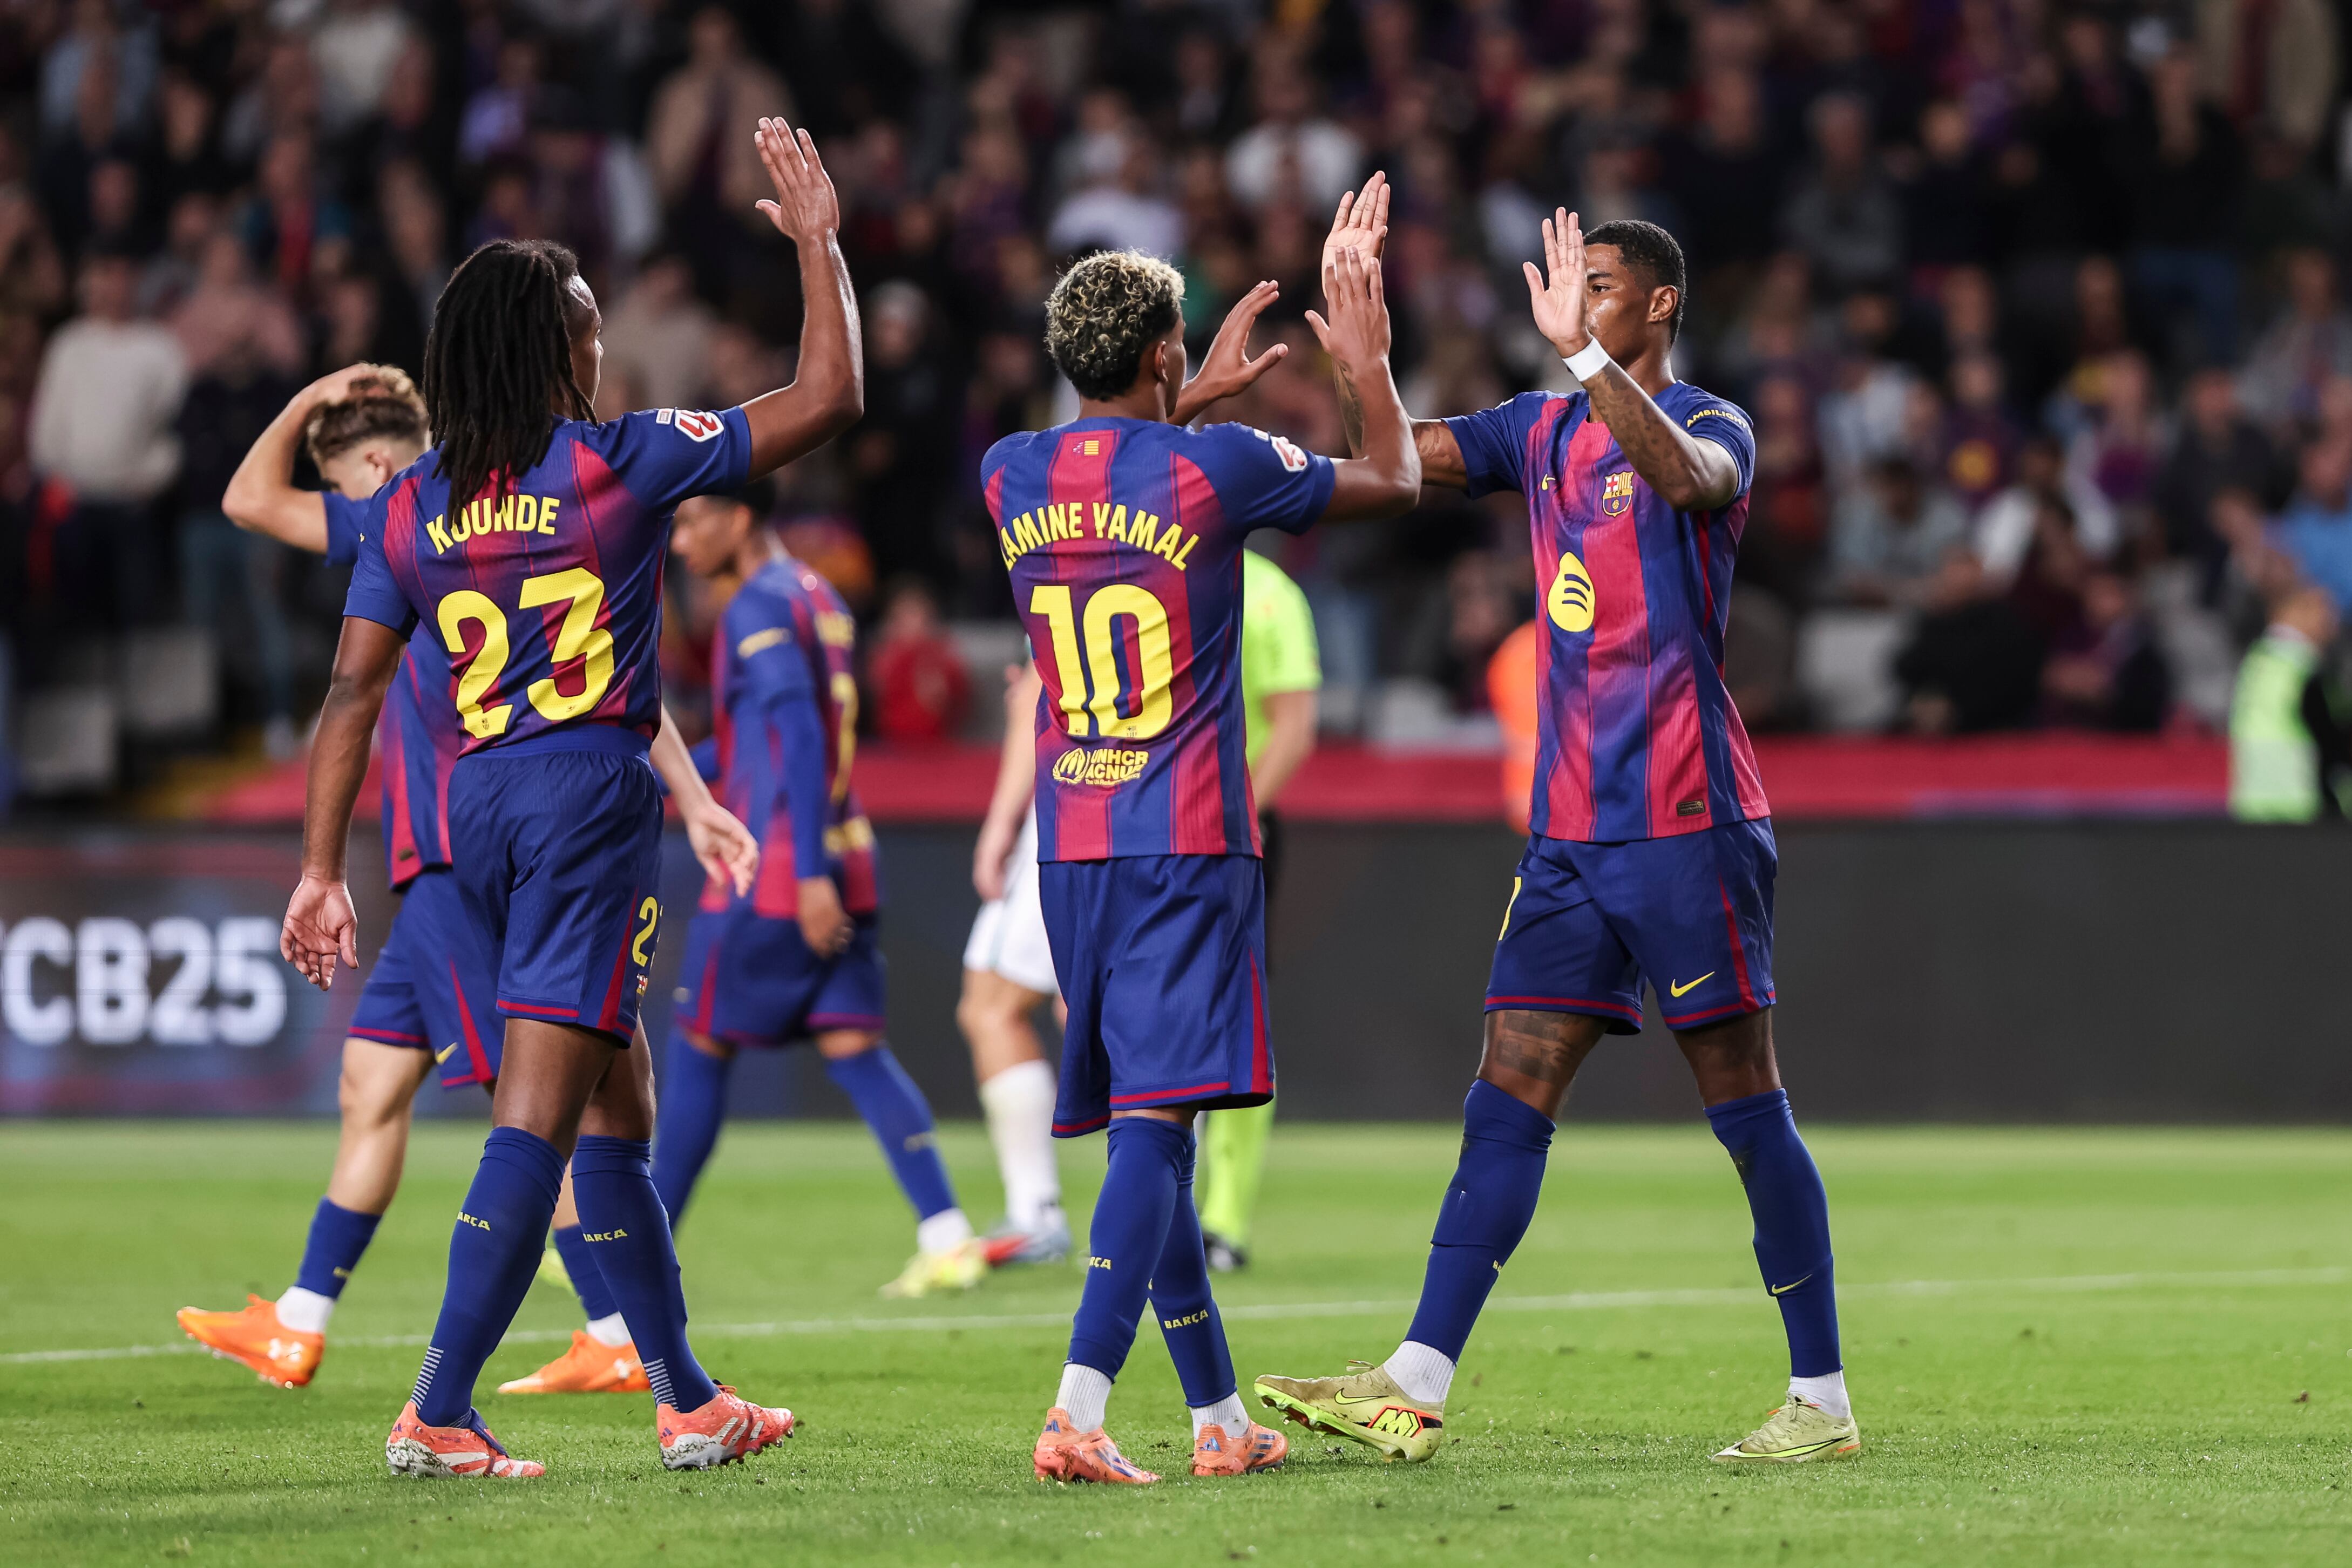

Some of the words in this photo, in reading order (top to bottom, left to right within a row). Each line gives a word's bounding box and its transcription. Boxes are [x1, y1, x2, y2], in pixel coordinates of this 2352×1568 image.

[1687, 409, 1746, 428] AMBILIGHT
[426, 494, 560, 555] KOUNDE
[1093, 502, 1199, 571] YAMAL
[437, 567, 615, 739] 23
[1029, 583, 1174, 739] 10
[1090, 748, 1149, 765] UNHCR
[632, 896, 663, 970] 2
[0, 917, 287, 1046] CB25
[457, 1211, 490, 1231] ARÇA
